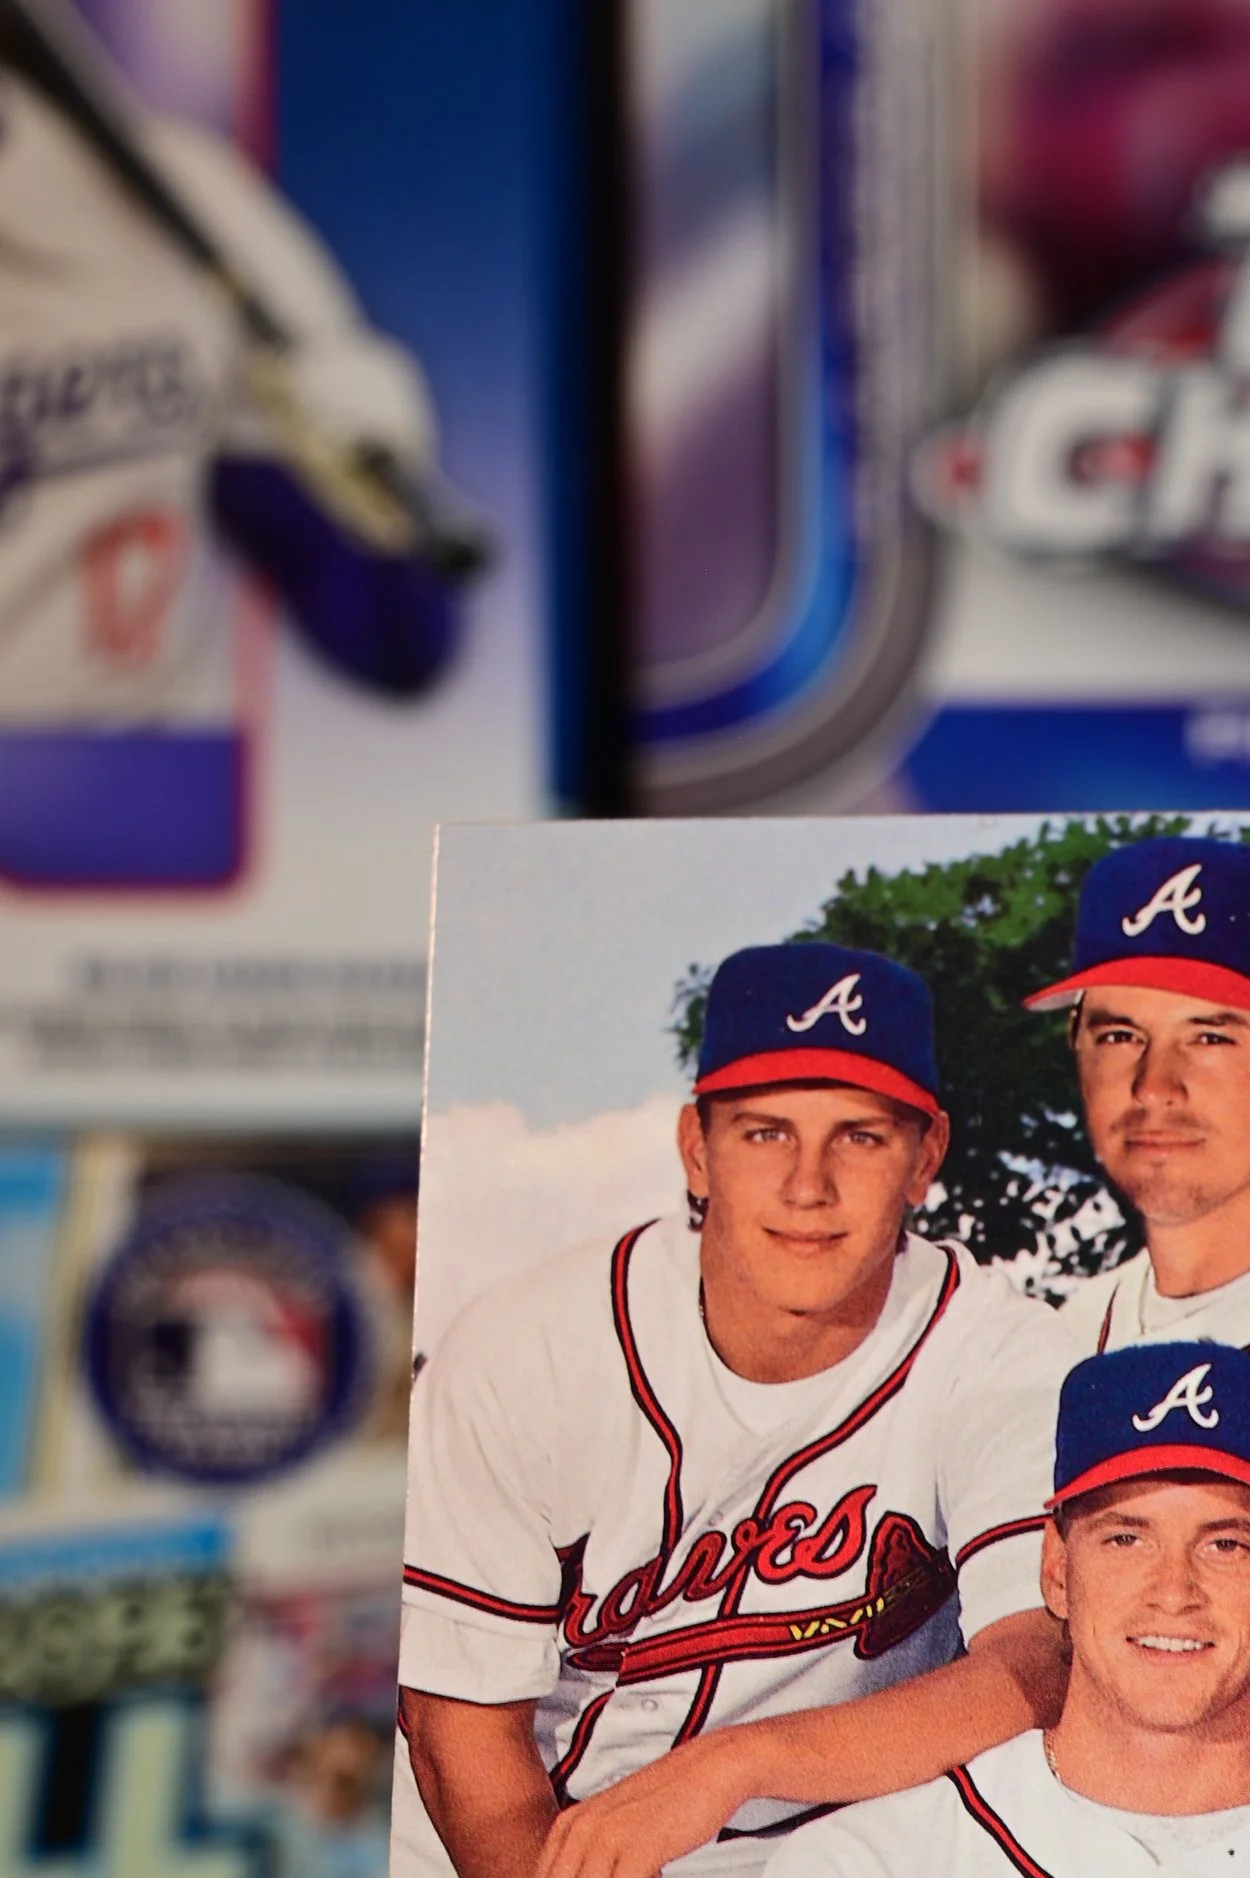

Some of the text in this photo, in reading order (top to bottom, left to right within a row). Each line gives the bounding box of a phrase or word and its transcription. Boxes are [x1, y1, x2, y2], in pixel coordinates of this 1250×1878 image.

[1122, 863, 1206, 937] A
[786, 973, 867, 1036] A
[1132, 1363, 1219, 1432] A
[558, 1484, 878, 1648] raves
